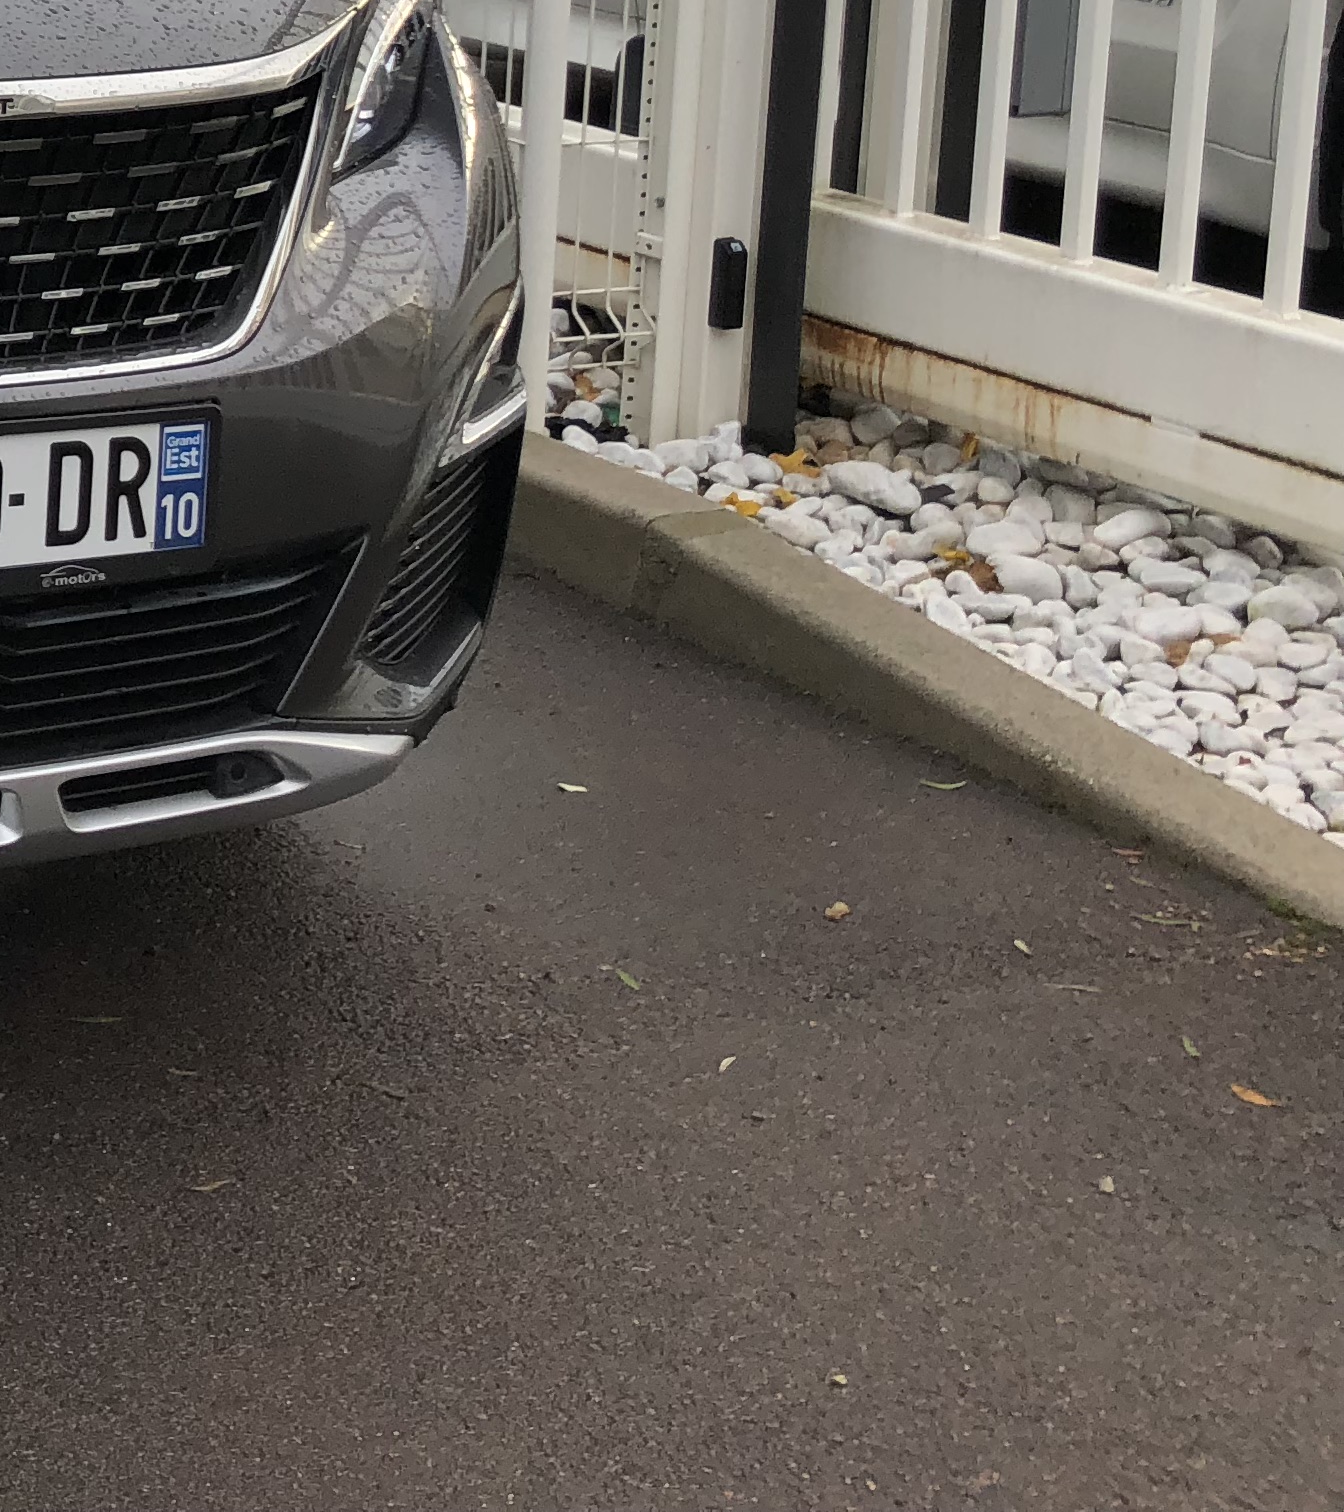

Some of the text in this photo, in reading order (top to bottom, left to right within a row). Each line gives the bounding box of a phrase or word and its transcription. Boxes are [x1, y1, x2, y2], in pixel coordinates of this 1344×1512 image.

[166, 433, 201, 448] Grand
[165, 446, 200, 470] Est
[160, 491, 200, 540] 10
